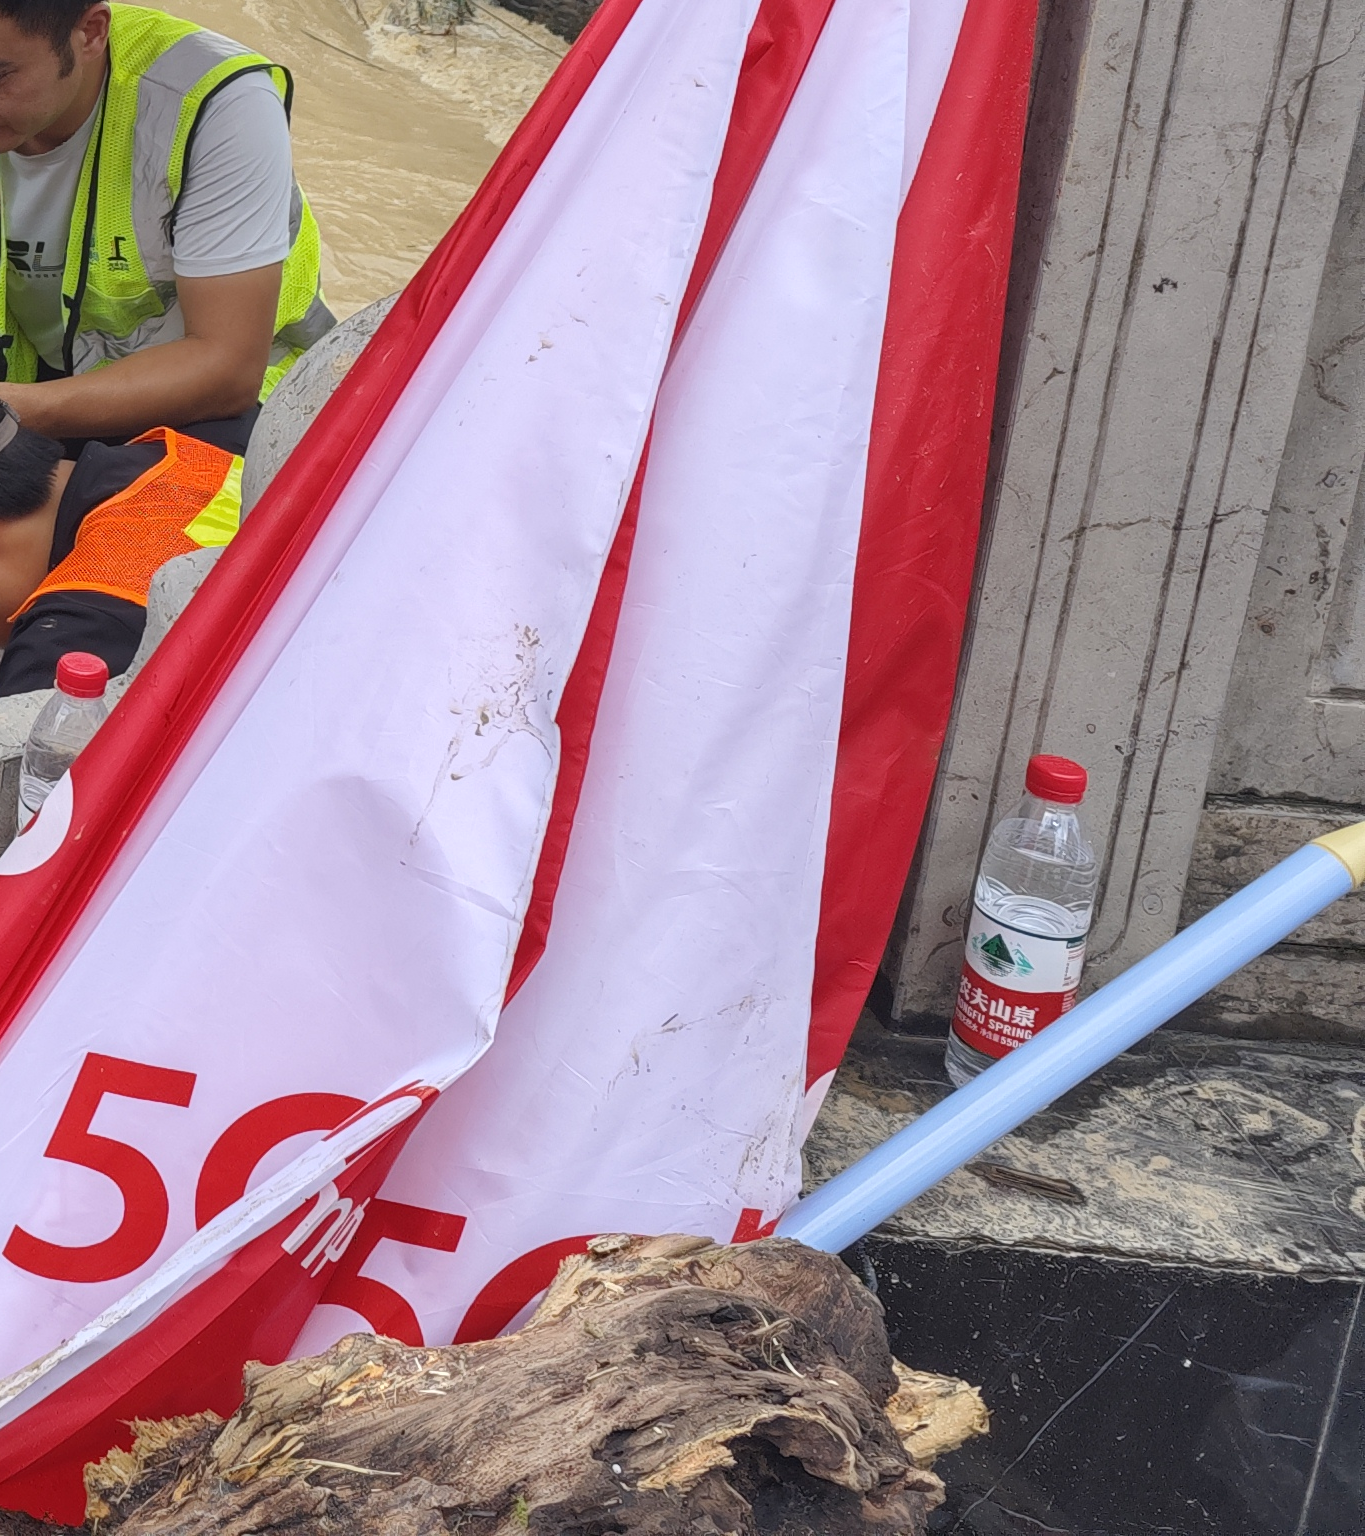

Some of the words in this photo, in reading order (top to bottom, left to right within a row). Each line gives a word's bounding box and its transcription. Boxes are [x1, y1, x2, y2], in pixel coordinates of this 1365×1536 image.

[958, 974, 1037, 1028] 农夫山泉
[987, 1019, 1034, 1041] SPRING
